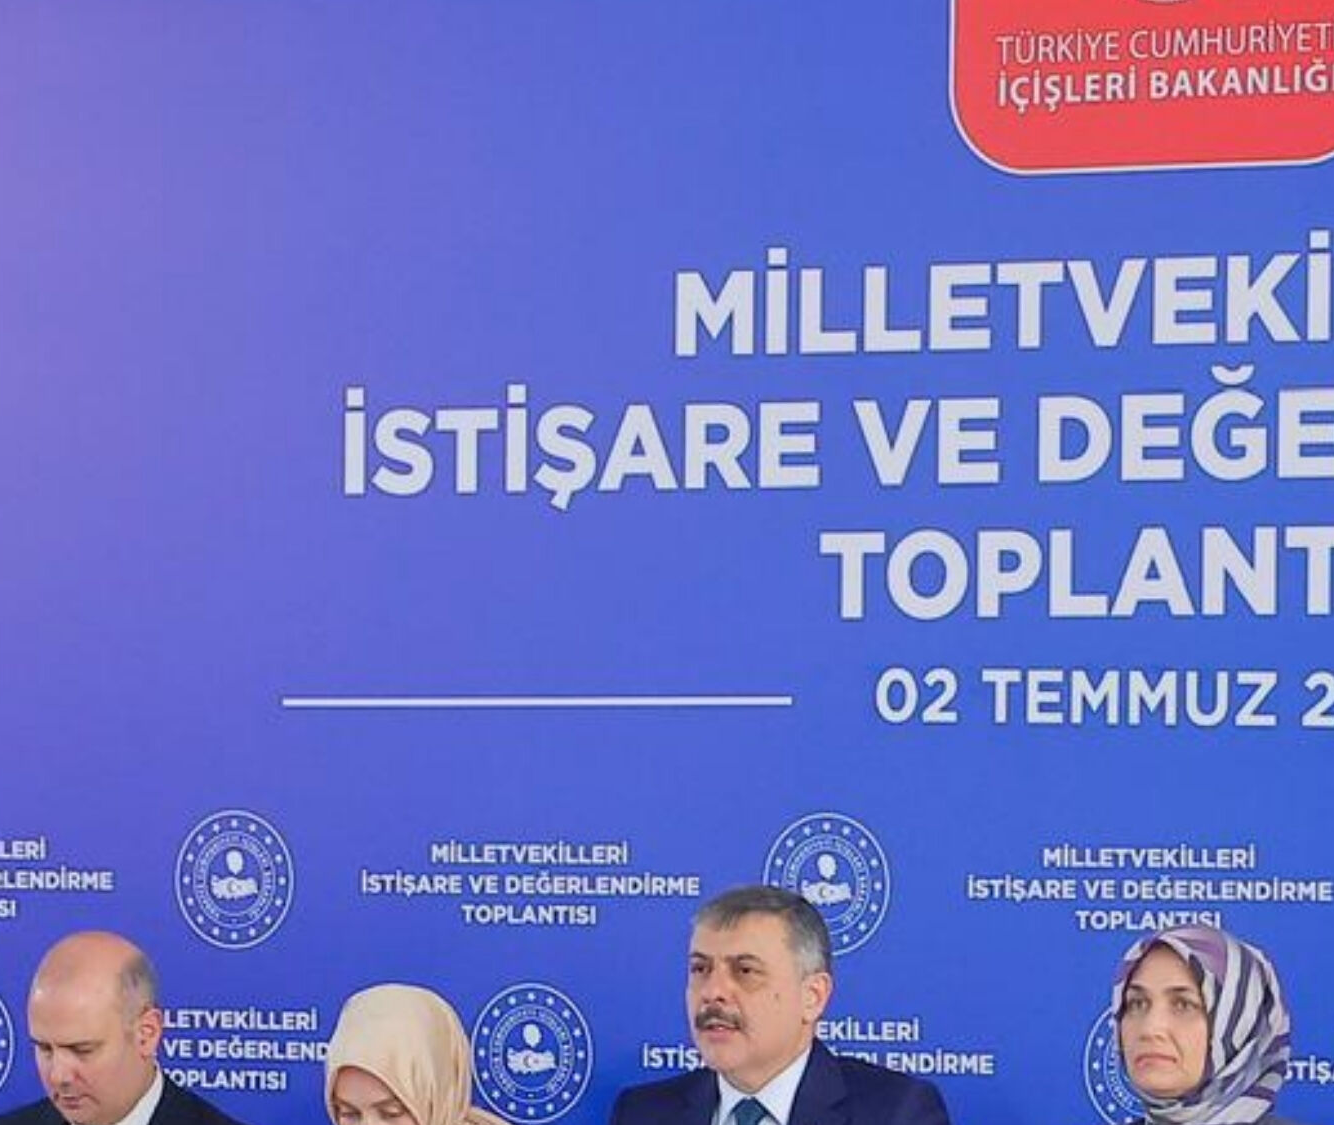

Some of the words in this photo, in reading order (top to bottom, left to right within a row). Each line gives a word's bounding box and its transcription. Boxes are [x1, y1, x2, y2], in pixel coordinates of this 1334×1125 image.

[996, 28, 1120, 65] TÜRKİYE
[998, 65, 1136, 112] İÇİŞLERİ
[344, 384, 820, 510] İSTİŞARE
[853, 397, 999, 485] VE
[876, 667, 957, 723] 02
[982, 669, 1277, 726] TEMMUZ
[431, 840, 628, 865] MİLLETVEKİLLERİ
[1043, 843, 1255, 869] MİLLETVEKİLLERİ
[361, 869, 462, 896] İSTİŞARE
[468, 874, 499, 894] VE
[504, 871, 700, 896] DEĞERLENDİRME
[968, 874, 1077, 902] İSTİŞARE
[1083, 879, 1116, 899] VE
[1122, 875, 1333, 901] DEĞERLENDİRME
[461, 904, 596, 925] TOPLANTISI
[164, 1007, 317, 1031] LETVEKİLLERİ
[816, 1016, 919, 1041] EKİLLERİ
[163, 1038, 192, 1058] VE
[198, 1034, 330, 1061] DEĞERLEND
[164, 1068, 287, 1091] OPLANTISI
